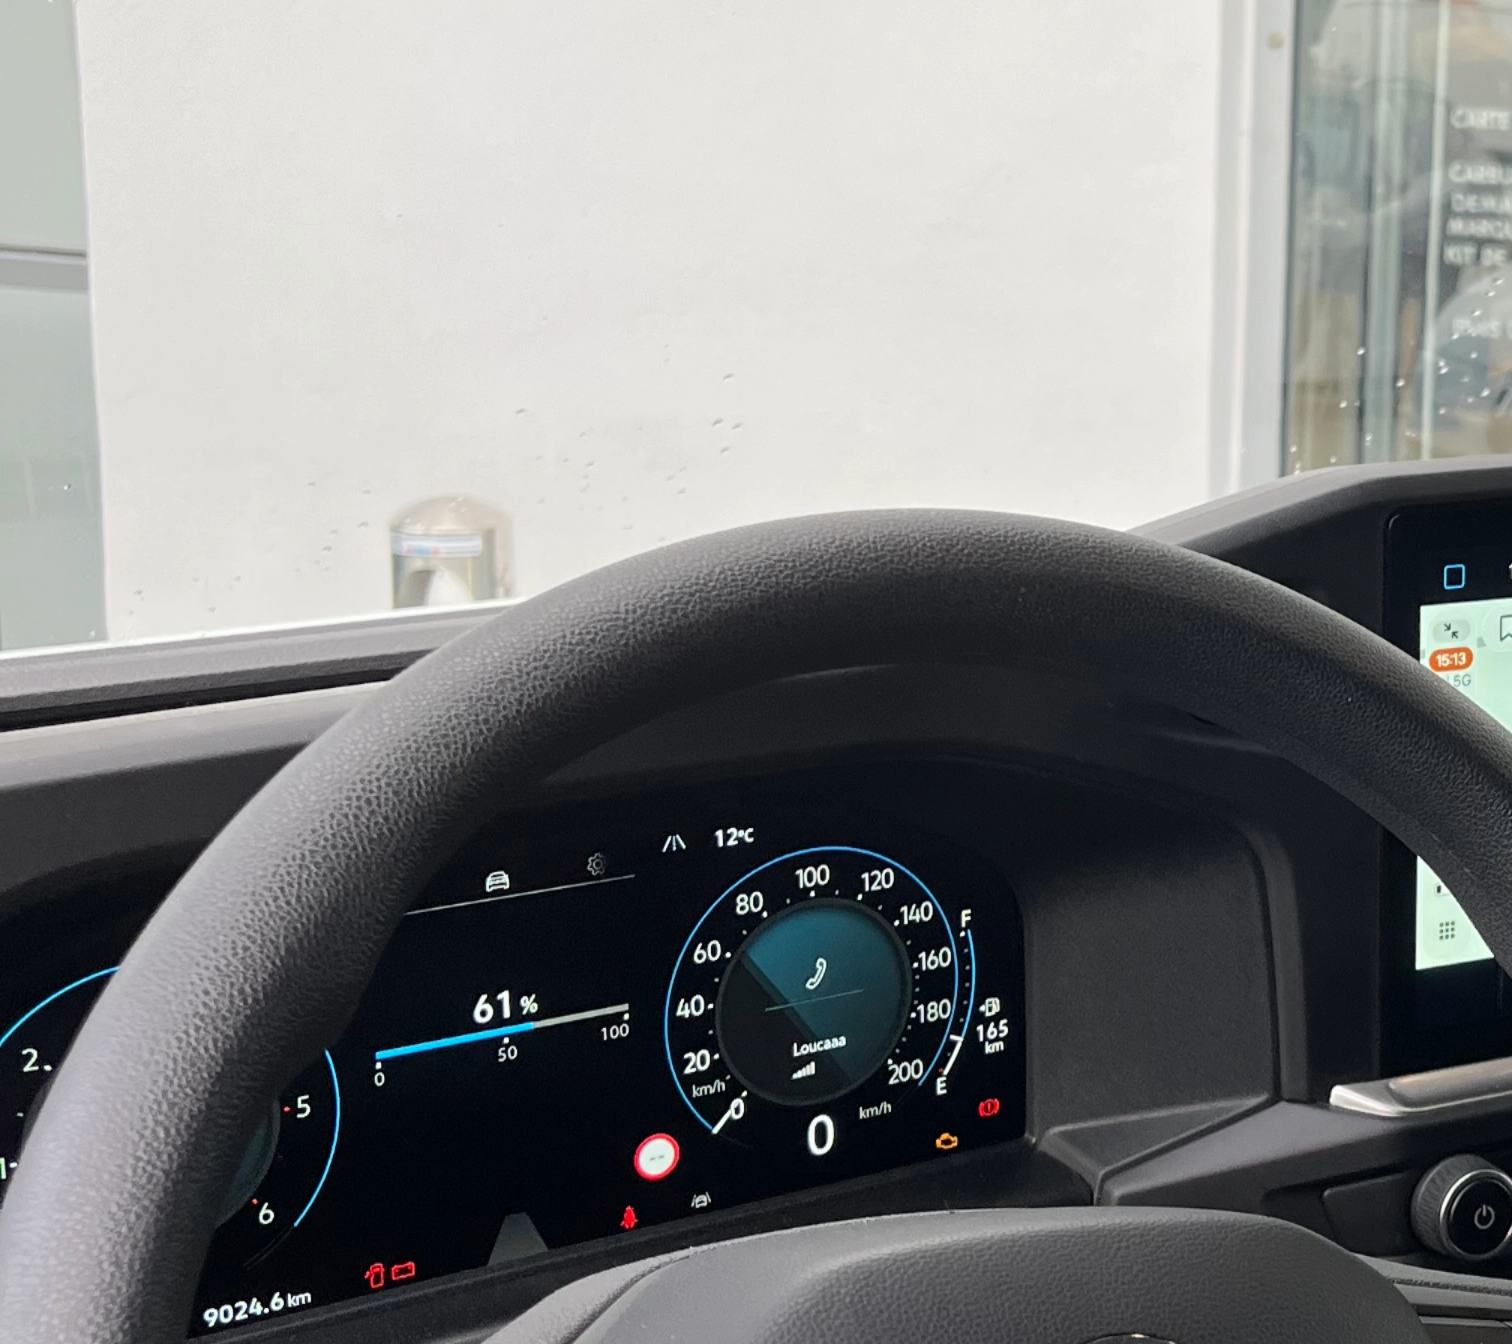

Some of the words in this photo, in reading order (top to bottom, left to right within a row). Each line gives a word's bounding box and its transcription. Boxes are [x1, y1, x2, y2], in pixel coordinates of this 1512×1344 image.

[1435, 651, 1467, 667] 15:13
[1453, 674, 1472, 687] 5G
[795, 864, 830, 889] 100
[861, 867, 895, 892] 120
[735, 891, 764, 915] 80
[900, 901, 934, 925] 140
[960, 909, 972, 929] F
[692, 940, 722, 964] 60
[917, 946, 952, 972] 160
[473, 989, 511, 1024] 61
[519, 993, 539, 1016] %
[675, 994, 705, 1019] 40
[916, 998, 951, 1025] 180
[600, 1022, 630, 1042] 100
[976, 1018, 1009, 1043] 165
[497, 1044, 518, 1063] 50
[792, 1035, 847, 1058] Loucaaa
[984, 1038, 1005, 1055] km
[21, 1047, 40, 1073] 2
[682, 1049, 711, 1075] 20
[887, 1058, 924, 1086] 200
[374, 1071, 385, 1087] 0
[691, 1078, 726, 1098] km/h
[935, 1076, 947, 1095] E
[296, 1094, 312, 1118] 5
[858, 1100, 892, 1120] km/h
[806, 1114, 836, 1156] 0
[258, 1201, 275, 1225] 6
[202, 1291, 285, 1328] 9024.6
[287, 1290, 312, 1308] km
